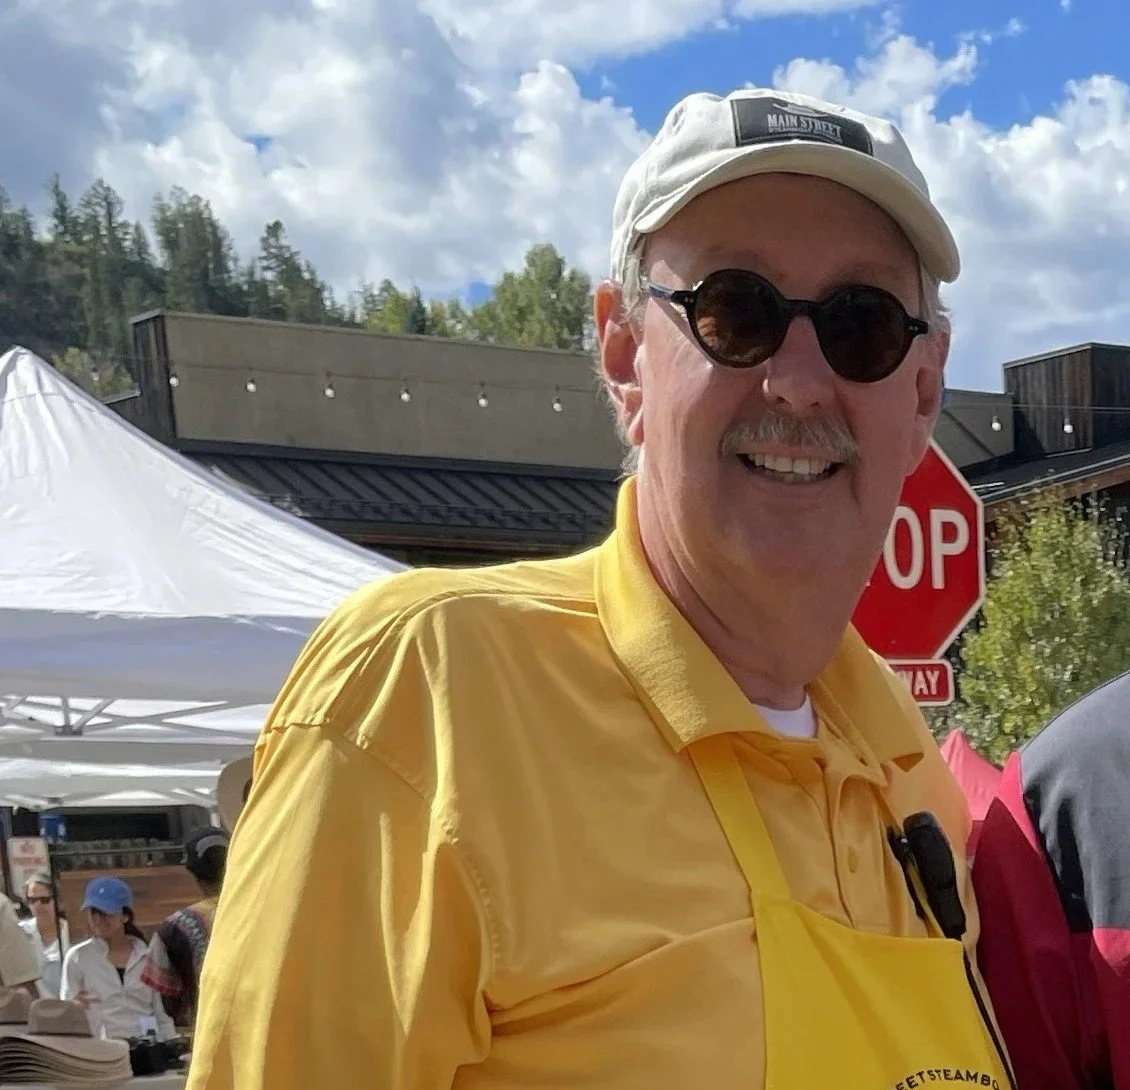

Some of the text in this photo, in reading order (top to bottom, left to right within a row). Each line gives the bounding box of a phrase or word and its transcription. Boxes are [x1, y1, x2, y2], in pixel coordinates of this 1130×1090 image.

[767, 114, 798, 128] MAIN
[801, 117, 842, 139] STREET
[883, 506, 970, 590] OP
